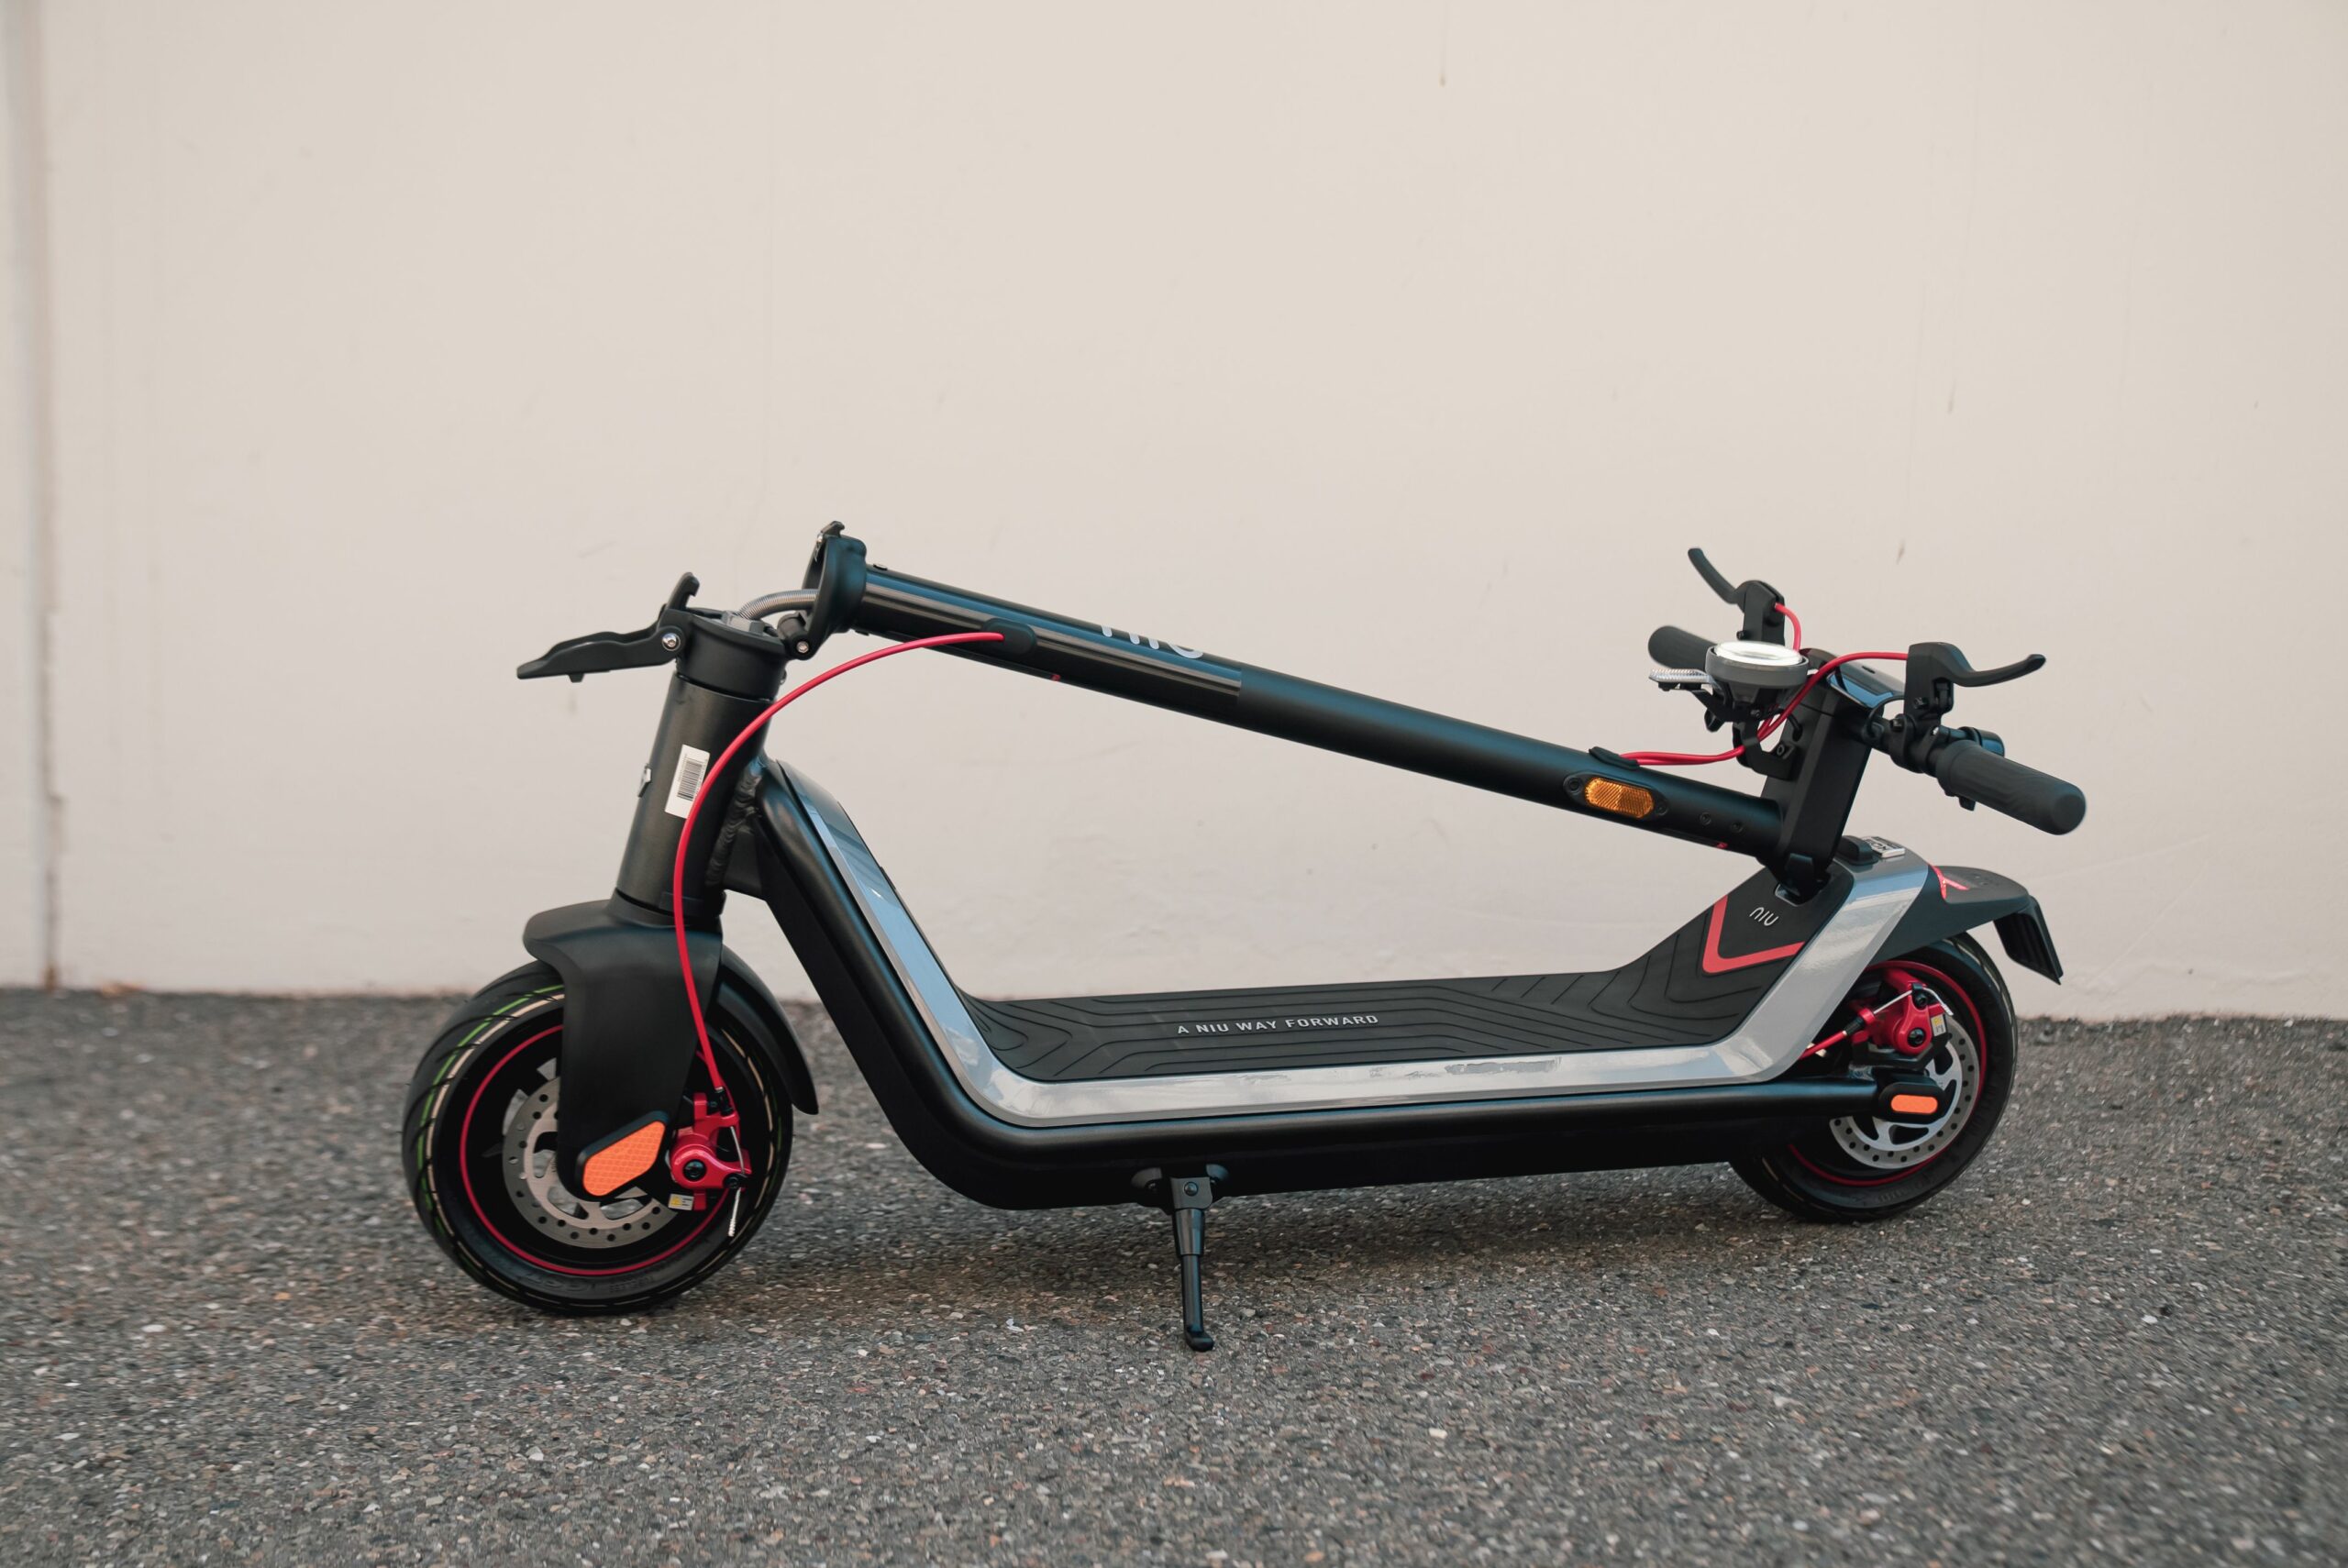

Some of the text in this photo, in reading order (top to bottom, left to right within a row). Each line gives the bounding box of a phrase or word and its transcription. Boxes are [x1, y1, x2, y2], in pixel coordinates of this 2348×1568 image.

[1177, 1014, 1379, 1034] A NIU WAY FORWARD
